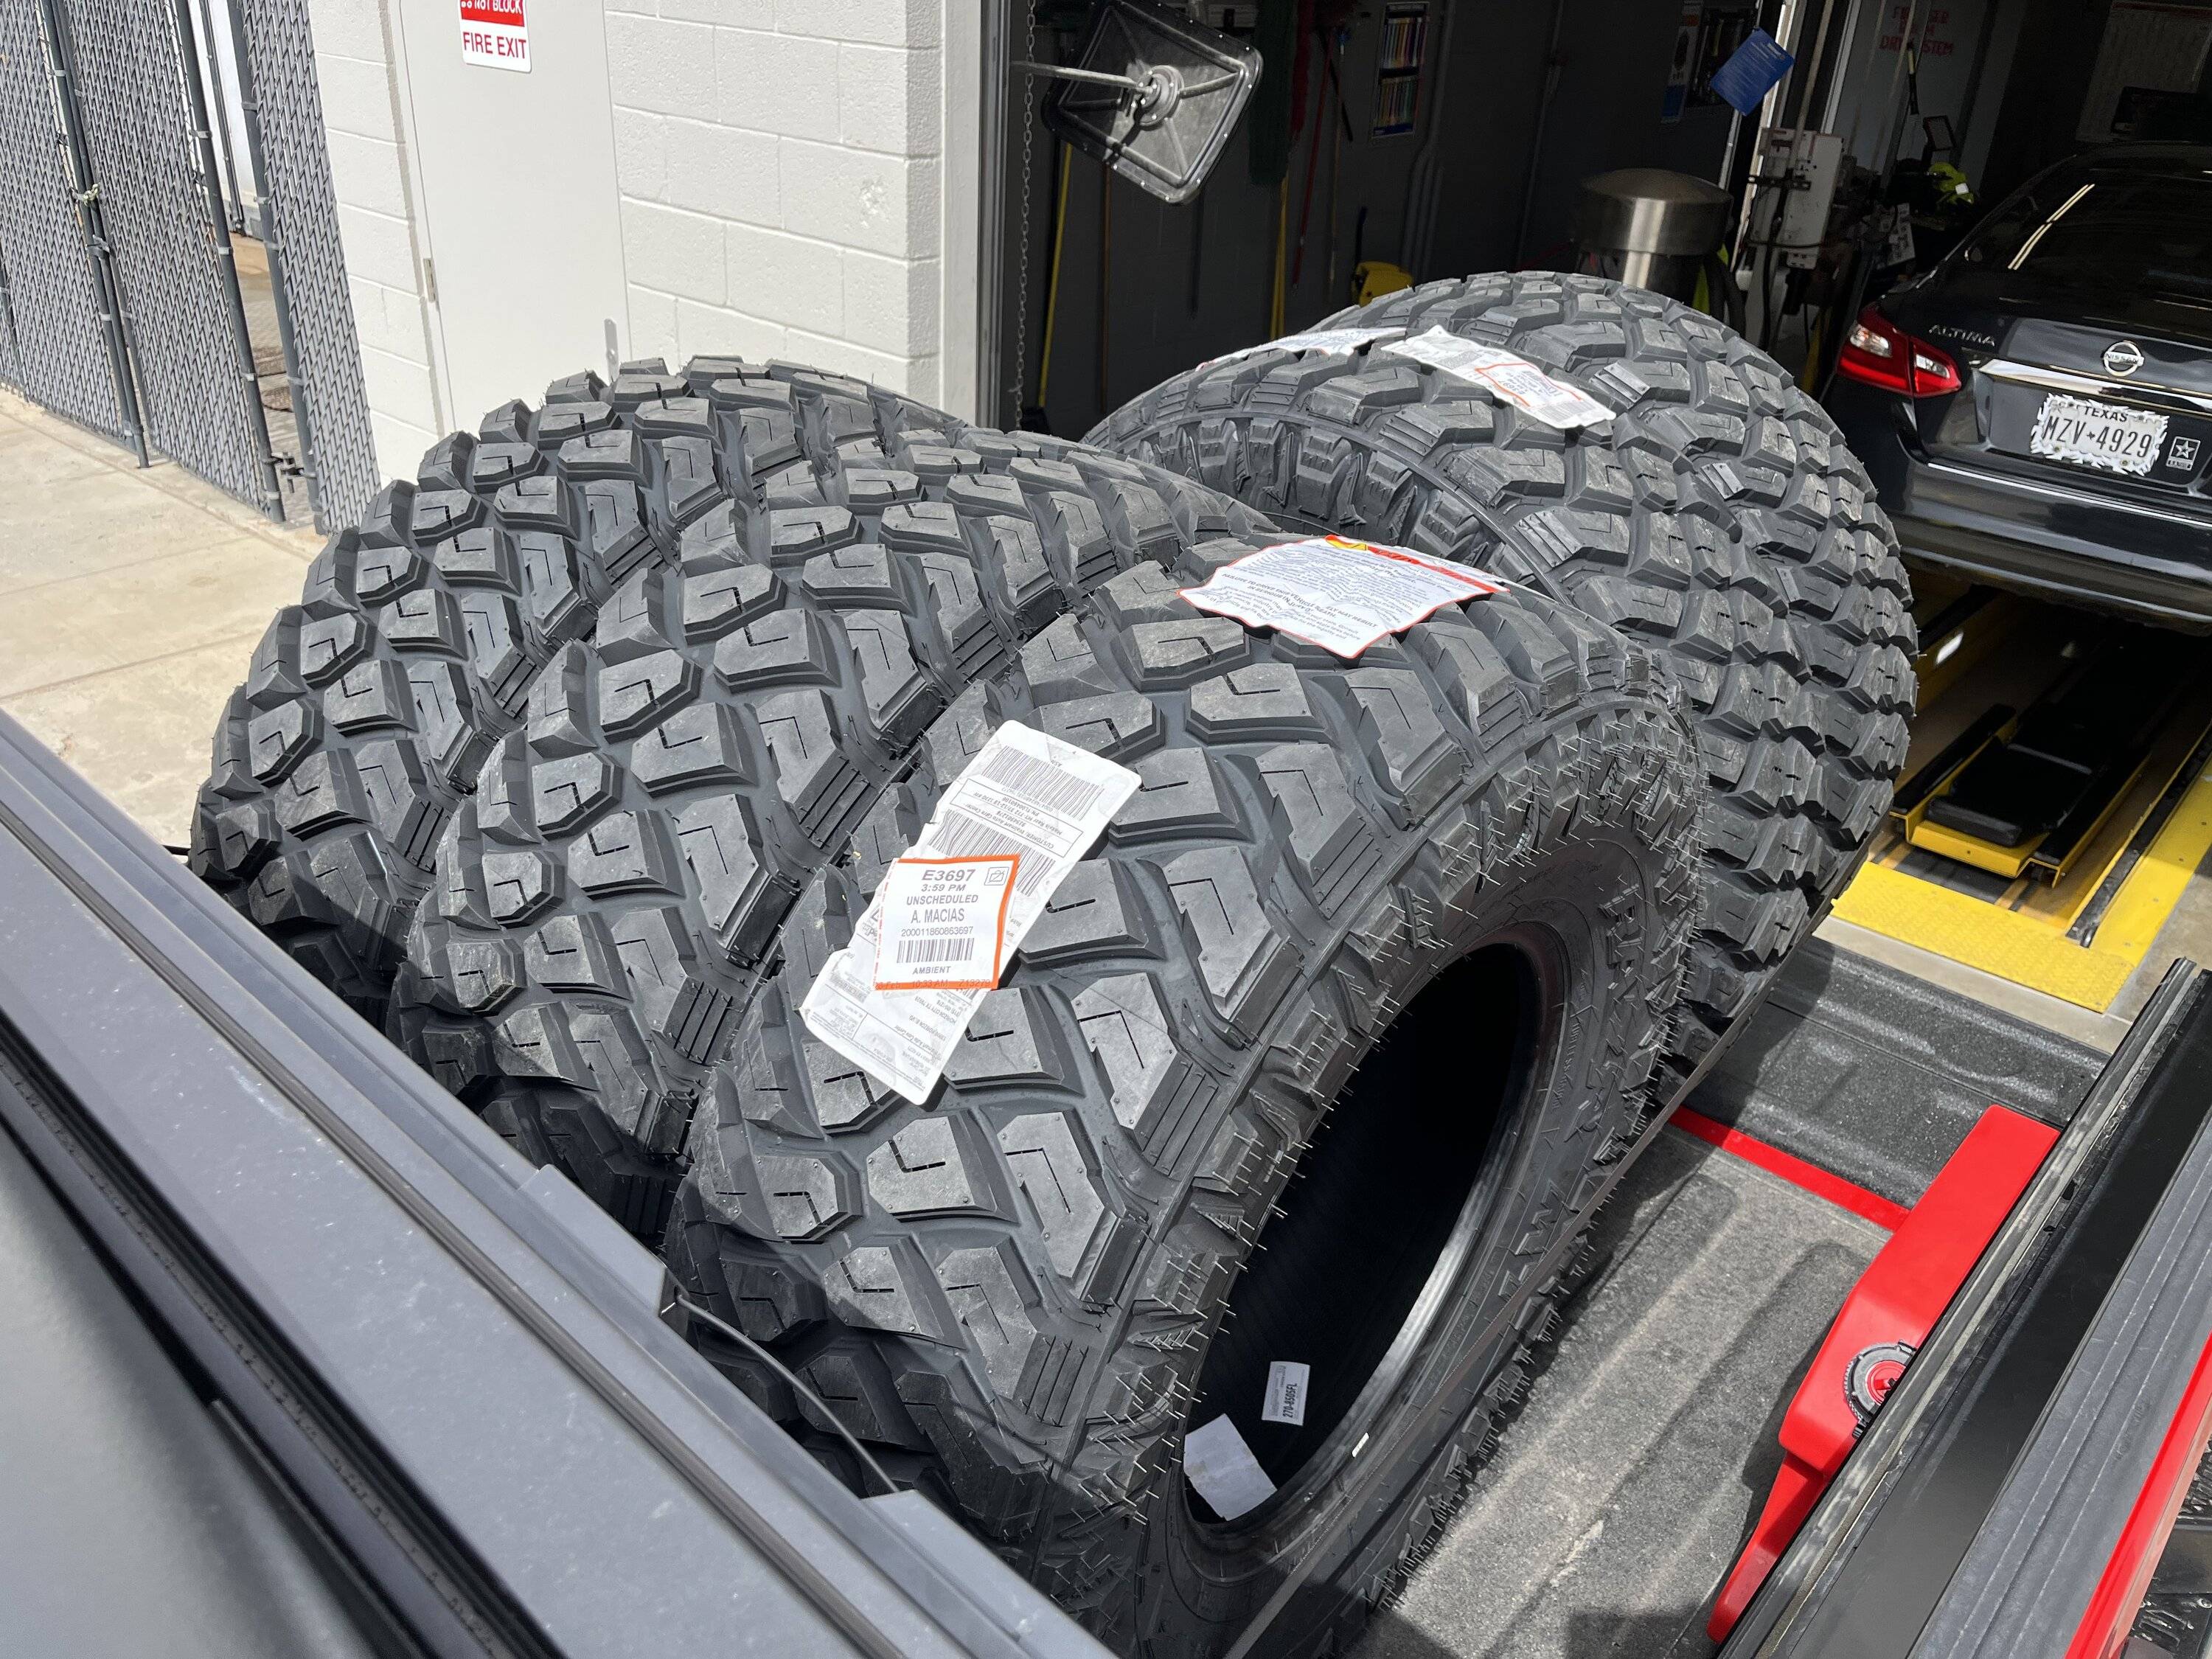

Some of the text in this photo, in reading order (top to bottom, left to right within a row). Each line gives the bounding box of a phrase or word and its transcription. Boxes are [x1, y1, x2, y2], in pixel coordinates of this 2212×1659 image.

[493, 0, 522, 15] BLOCK
[463, 32, 526, 59] FIRE EXIT
[1929, 324, 1995, 347] ALTIMA
[2105, 352, 2138, 364] NISSAN
[2084, 406, 2129, 422] TEXAS
[2042, 415, 2152, 457] MZV 4929
[922, 869, 975, 881] E3697
[906, 894, 978, 905] UNSCHEDULED
[911, 908, 964, 923] A. MACIAS
[912, 966, 951, 975] AMBIENT
